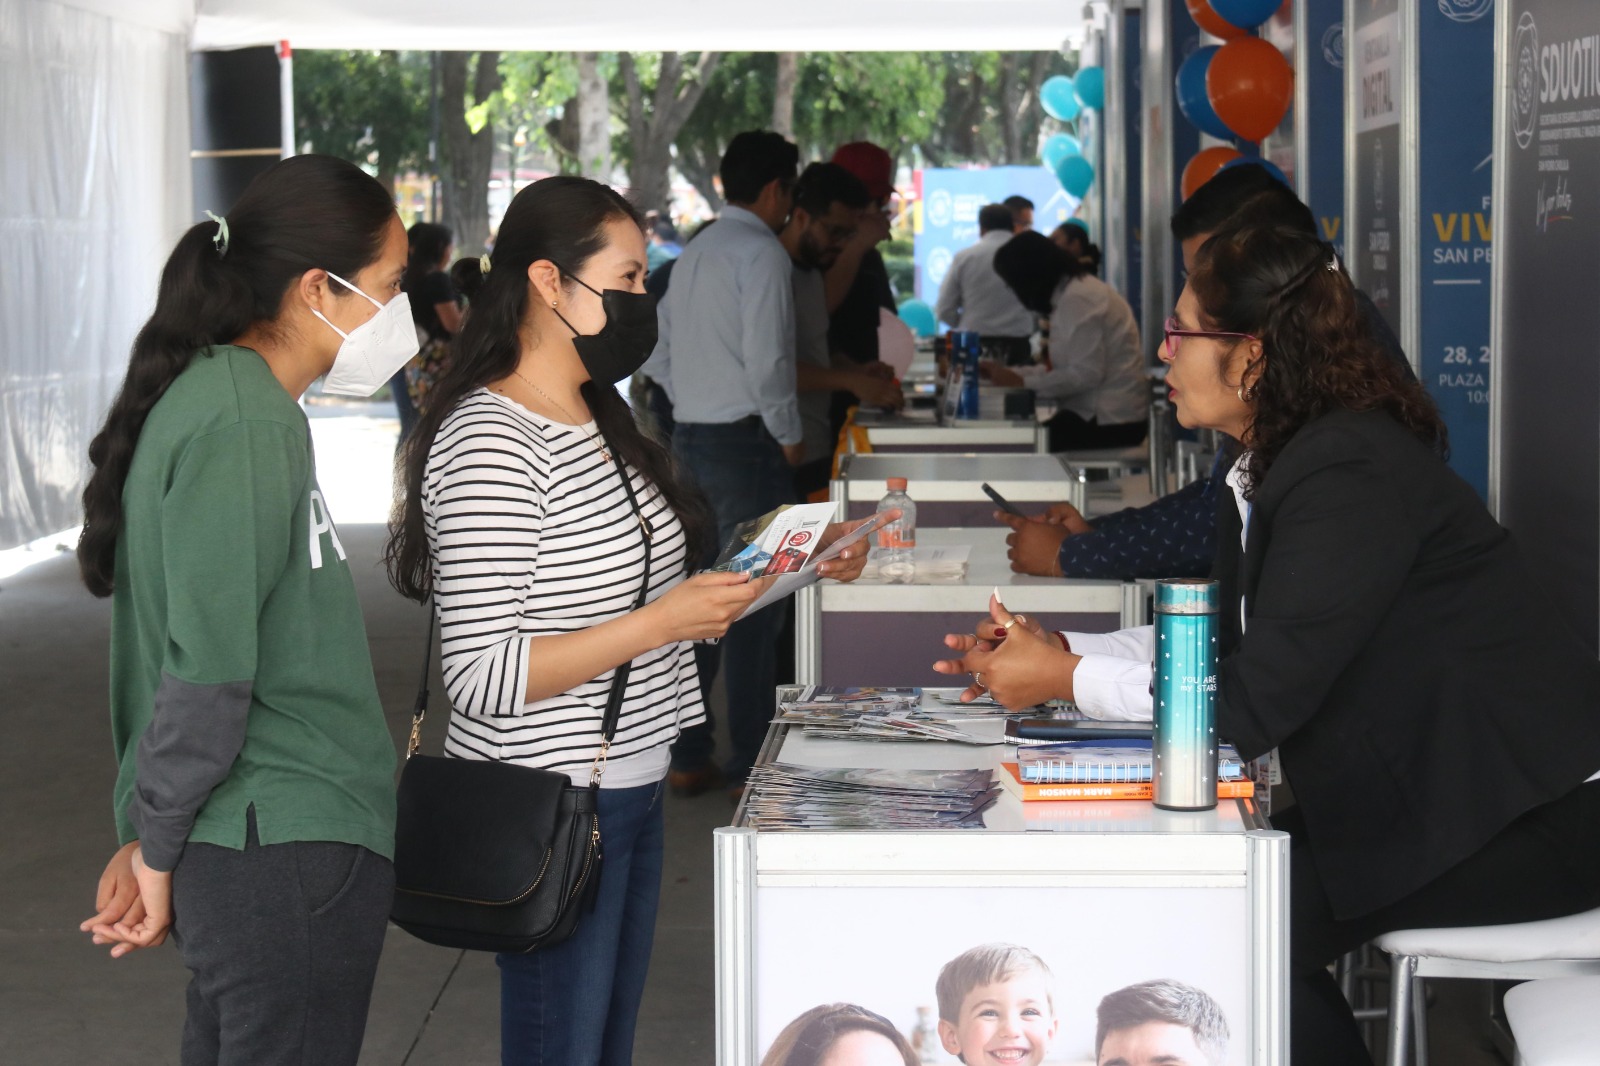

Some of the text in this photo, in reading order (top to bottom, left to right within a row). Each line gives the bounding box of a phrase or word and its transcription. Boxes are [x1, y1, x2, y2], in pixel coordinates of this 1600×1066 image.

[1432, 213, 1492, 242] VIV
[1433, 248, 1468, 264] SAN
[1443, 346, 1472, 366] 28,
[1439, 374, 1484, 387] PLAZA
[1203, 675, 1216, 684] ARE
[1197, 684, 1217, 692] STARS
[1039, 788, 1112, 797] MARK MANSON
